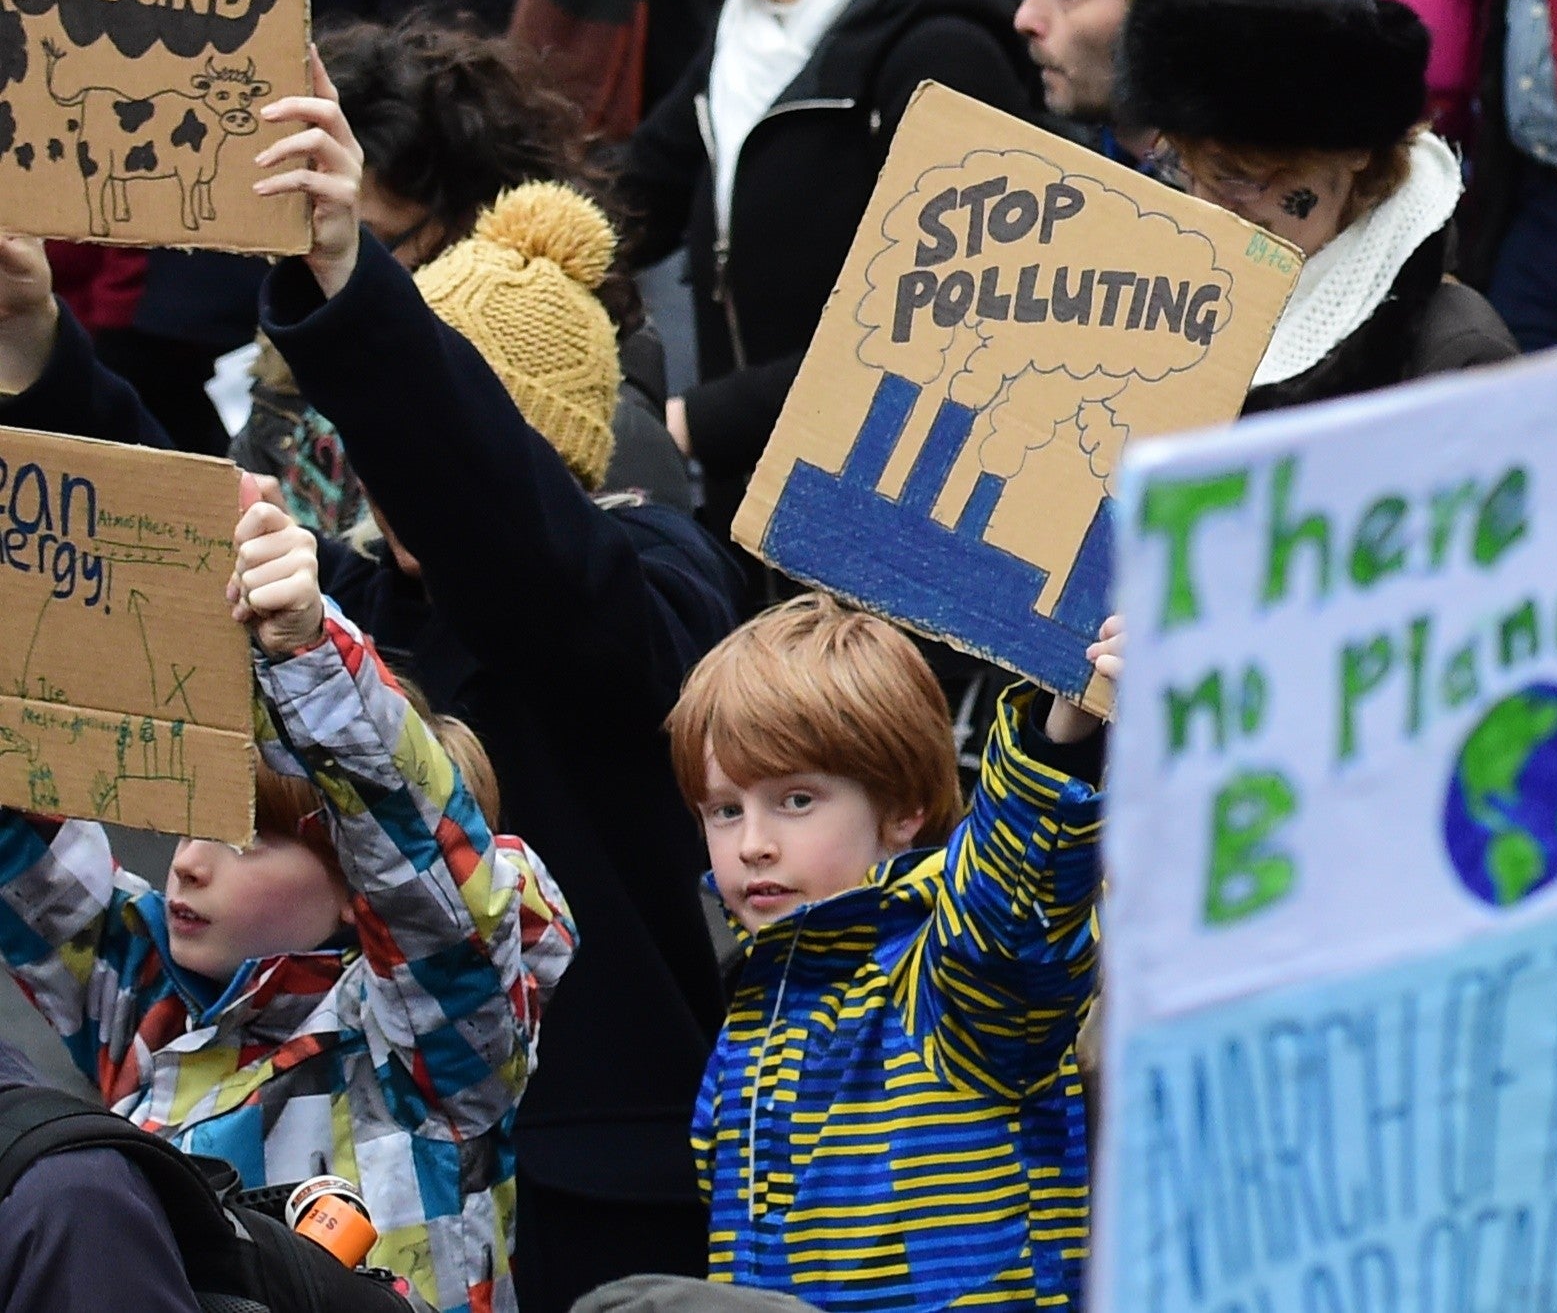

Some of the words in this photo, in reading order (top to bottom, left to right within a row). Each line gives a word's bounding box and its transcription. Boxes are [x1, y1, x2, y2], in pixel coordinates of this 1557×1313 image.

[914, 175, 1086, 267] STOP
[891, 264, 1222, 346] POLLUTING
[1137, 456, 1532, 630] There
[1161, 661, 1266, 758] no
[1202, 764, 1296, 929] B
